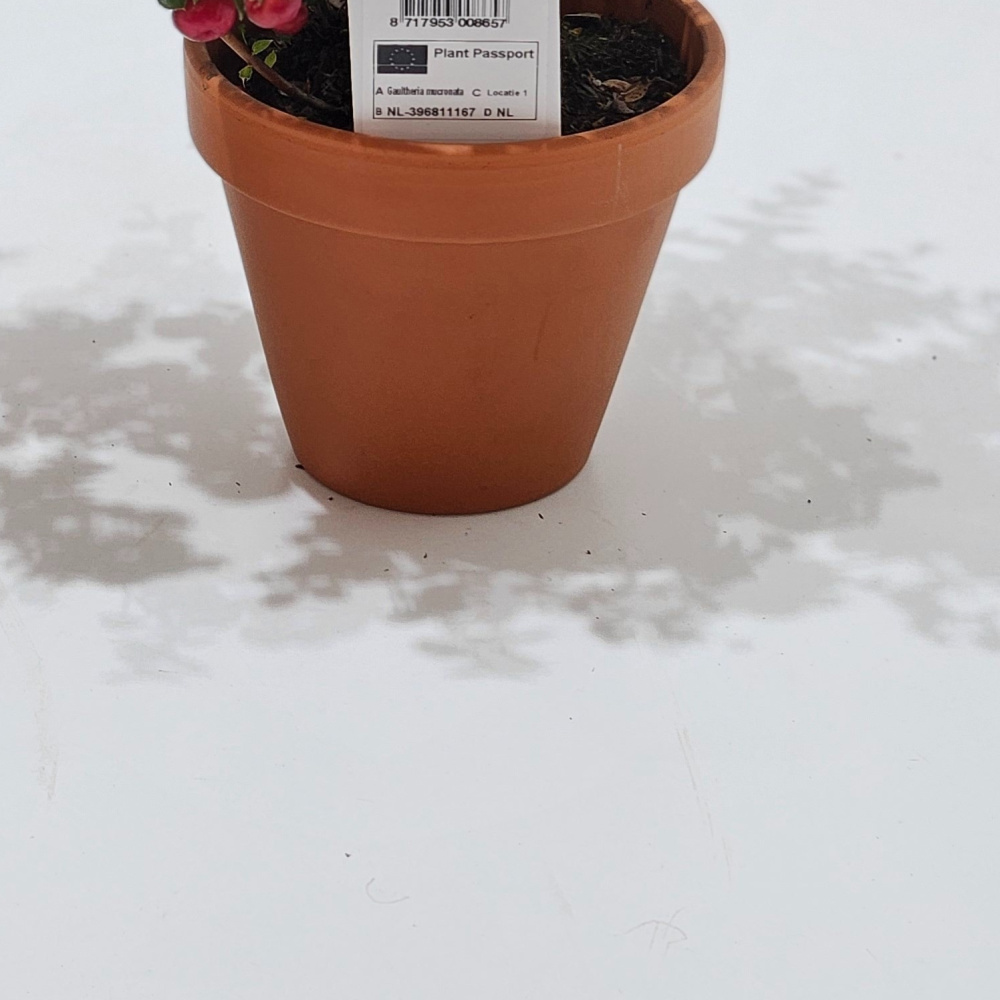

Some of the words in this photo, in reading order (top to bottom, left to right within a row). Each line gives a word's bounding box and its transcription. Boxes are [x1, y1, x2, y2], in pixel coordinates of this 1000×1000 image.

[390, 18, 398, 27] 8
[405, 18, 454, 27] 717953
[458, 18, 507, 28] 008657
[434, 48, 469, 58] Plant
[473, 49, 534, 60] Passport
[387, 87, 424, 95] Gaultheria
[387, 108, 475, 116] NL-396811167
